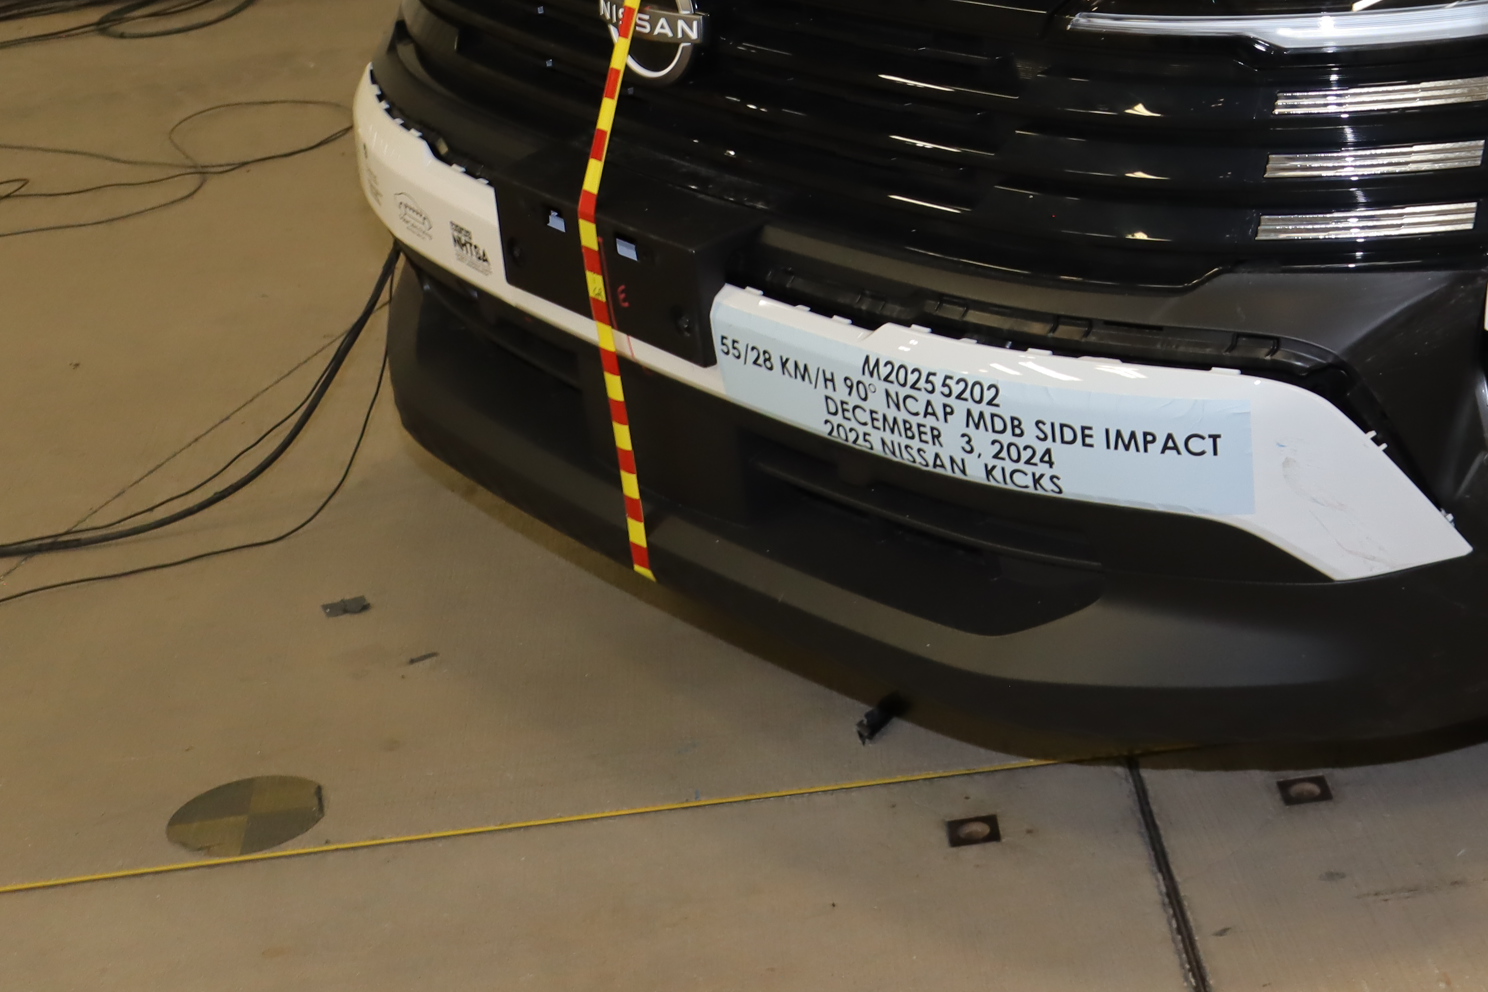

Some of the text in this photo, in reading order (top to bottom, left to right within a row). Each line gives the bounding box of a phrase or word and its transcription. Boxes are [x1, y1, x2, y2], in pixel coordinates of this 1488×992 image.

[720, 334, 1222, 456] 55/28 KM/H 90° NCAP MDB SIDE IMPACT
[862, 355, 1001, 407] M20255202
[824, 394, 1055, 469] DECEMBER 3, 2024
[824, 419, 1064, 494] 2025 NISSAN KICKS
